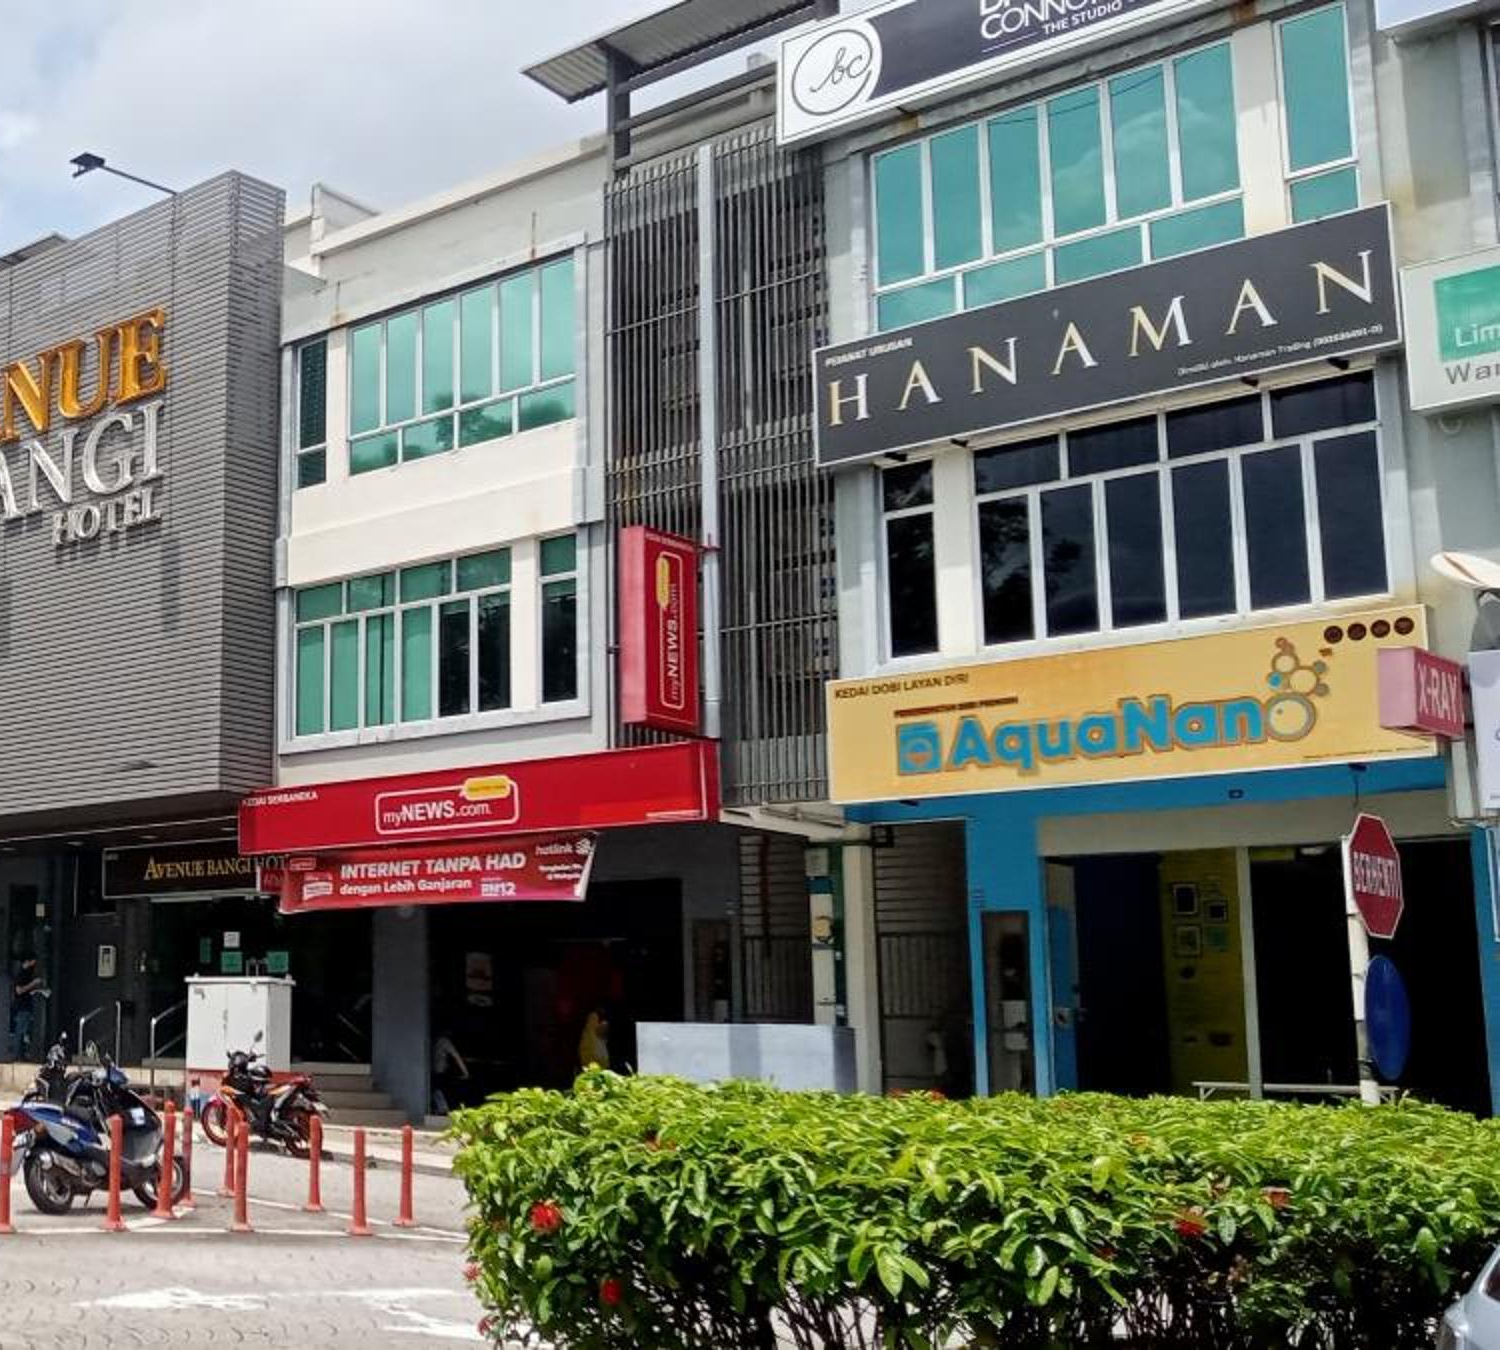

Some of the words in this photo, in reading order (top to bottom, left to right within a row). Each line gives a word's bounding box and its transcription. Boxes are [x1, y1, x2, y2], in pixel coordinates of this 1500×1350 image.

[1043, 20, 1068, 35] THE
[1071, 0, 1123, 26] STUDIO
[830, 249, 1373, 427] HANAMAN
[52, 487, 162, 544] HOTEL
[835, 686, 870, 700] KEDAI
[872, 682, 901, 695] DOBI
[903, 677, 943, 692] LAYAN
[945, 673, 970, 687] DIRI
[1418, 662, 1459, 724] X-RAY
[947, 692, 1316, 776] AquaNano
[144, 855, 205, 881] AVENUE
[207, 856, 252, 877] BANGI
[340, 860, 422, 879] INTERNET
[425, 855, 482, 874] TANPA
[484, 851, 527, 871] HAD
[1353, 851, 1400, 899] BERHENTI
[339, 882, 383, 897] dengan
[384, 880, 414, 894] Lebih
[417, 878, 472, 893] Ganjaran
